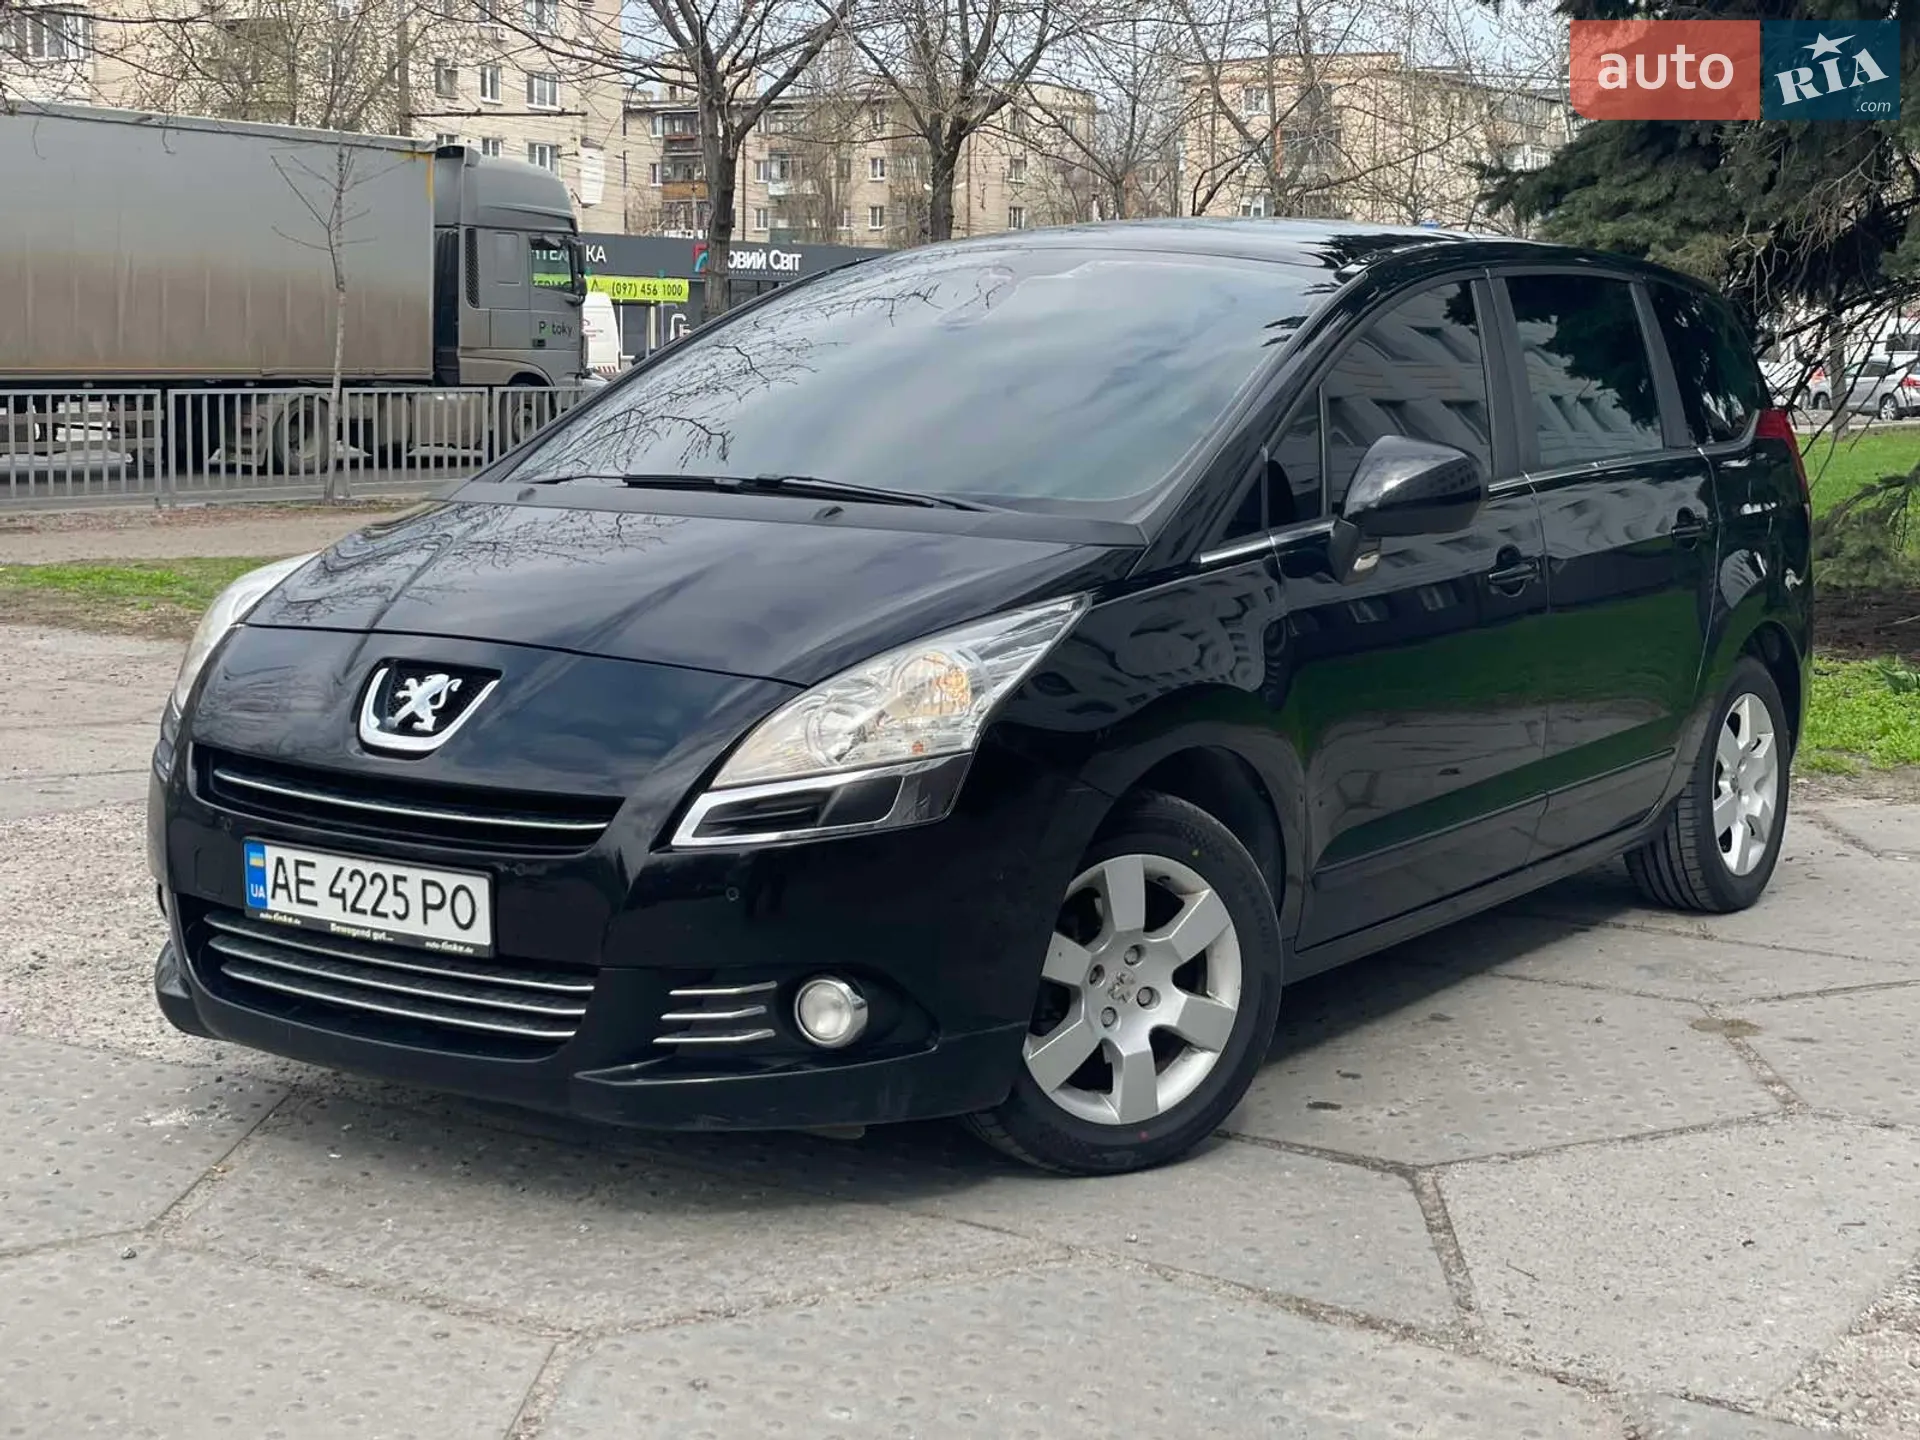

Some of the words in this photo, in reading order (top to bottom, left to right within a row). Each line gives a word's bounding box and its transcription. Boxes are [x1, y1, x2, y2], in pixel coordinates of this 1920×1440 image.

[611, 281, 638, 298] (097)
[640, 283, 658, 296] 456
[662, 284, 683, 297] 1000
[250, 883, 266, 899] UA
[270, 856, 319, 907] AE
[328, 866, 411, 921] 4225
[421, 878, 477, 931] PO
